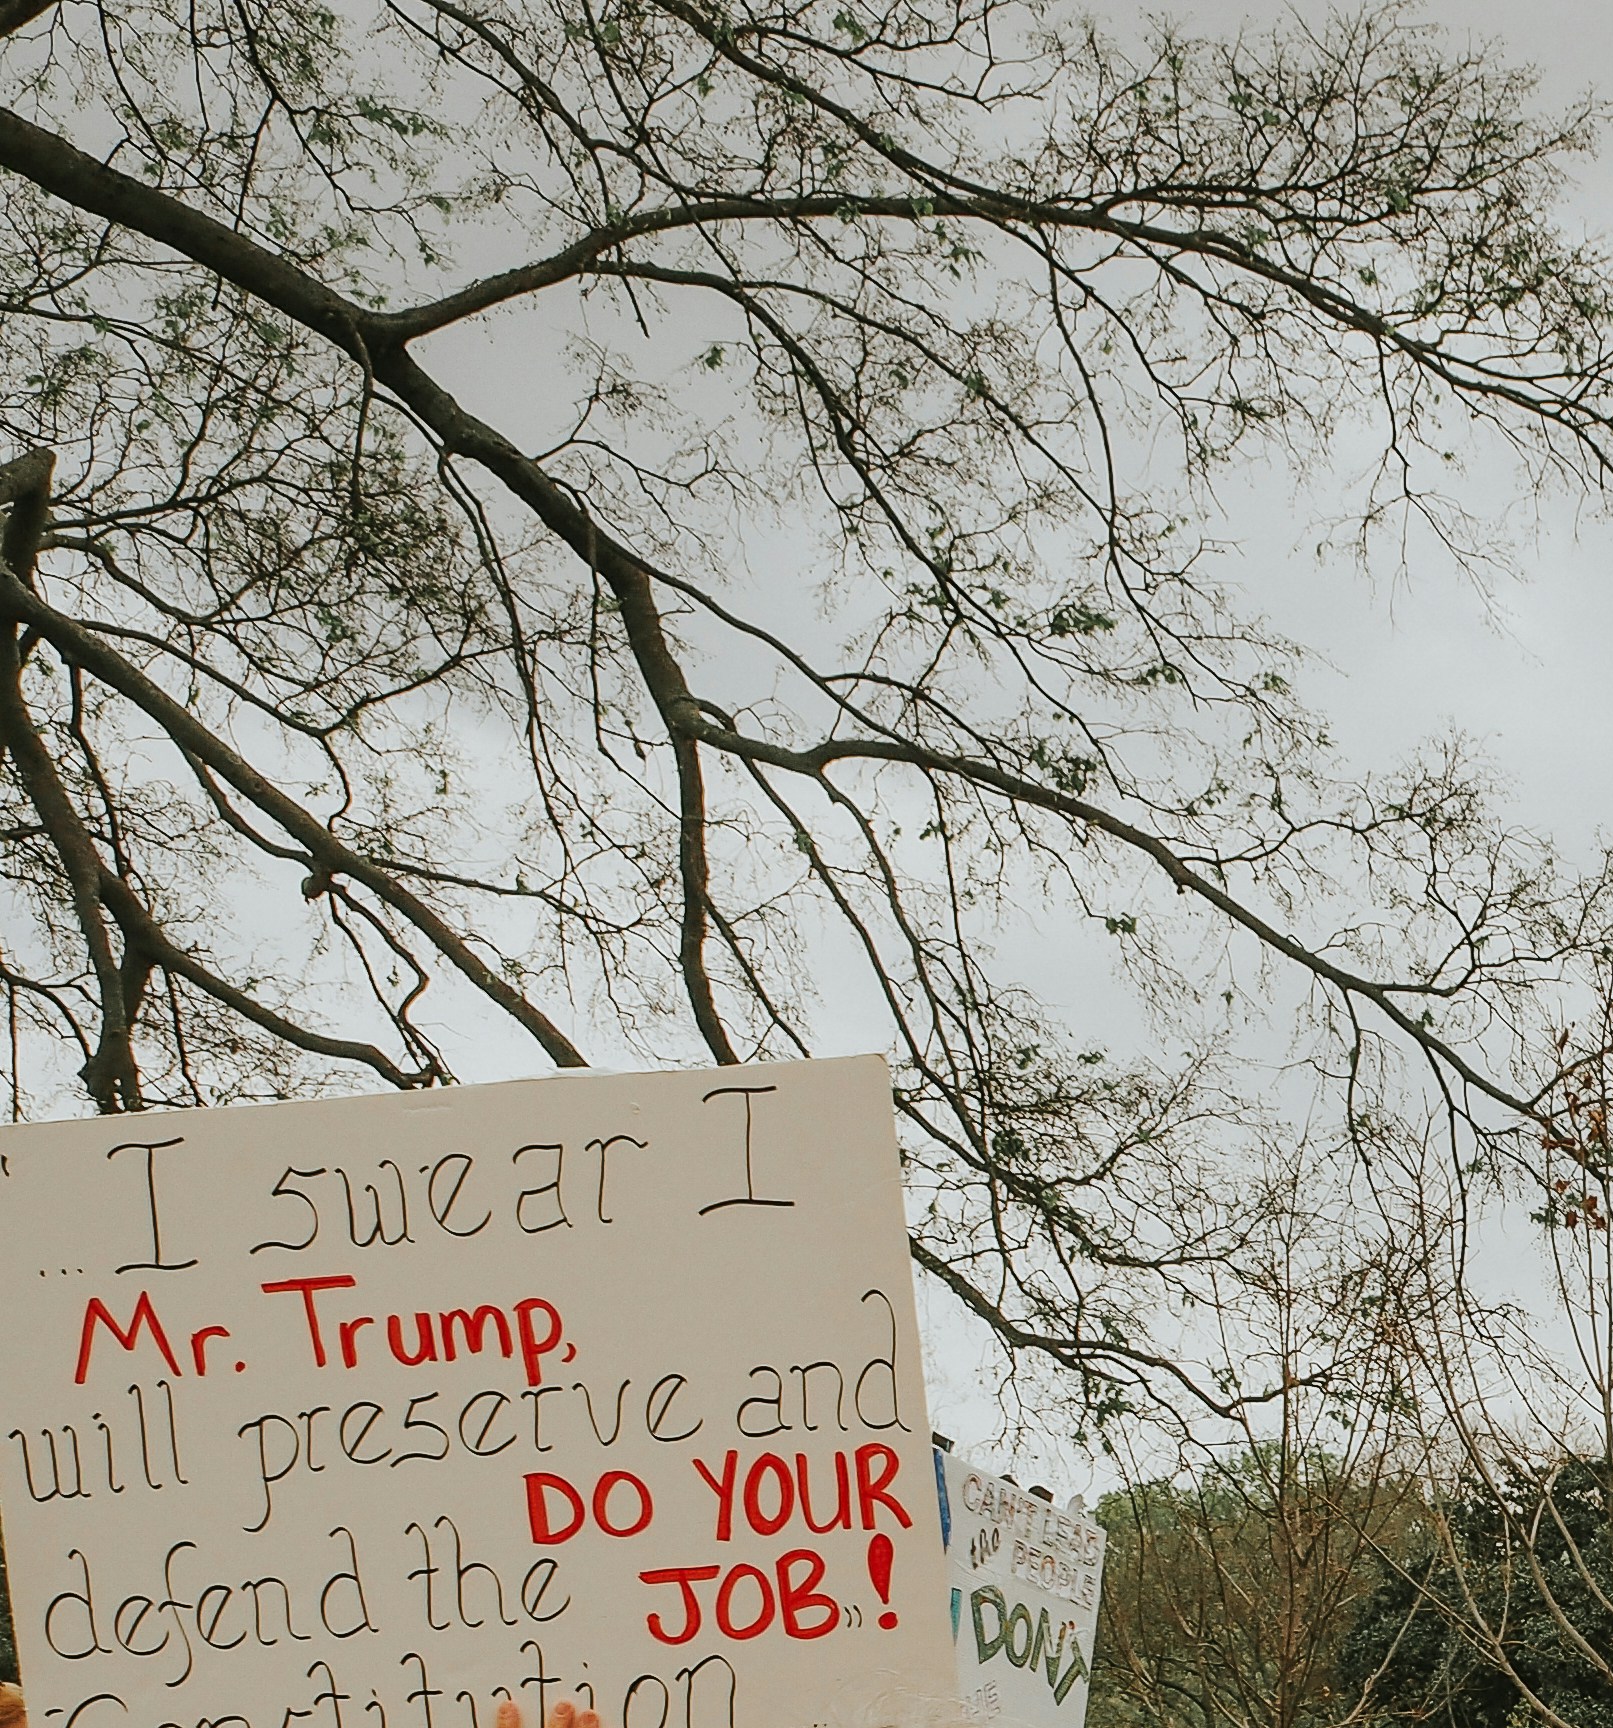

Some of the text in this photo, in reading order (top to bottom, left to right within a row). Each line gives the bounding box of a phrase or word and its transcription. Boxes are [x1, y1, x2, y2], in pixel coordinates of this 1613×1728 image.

[249, 1131, 648, 1256] swear
[699, 1085, 796, 1216] I
[9, 1289, 912, 1532] will preserve and
[75, 1275, 577, 1386] Mr. Trump,
[522, 1470, 653, 1545] DO
[692, 1443, 913, 1541] YOUR
[45, 1516, 571, 1687] defend the
